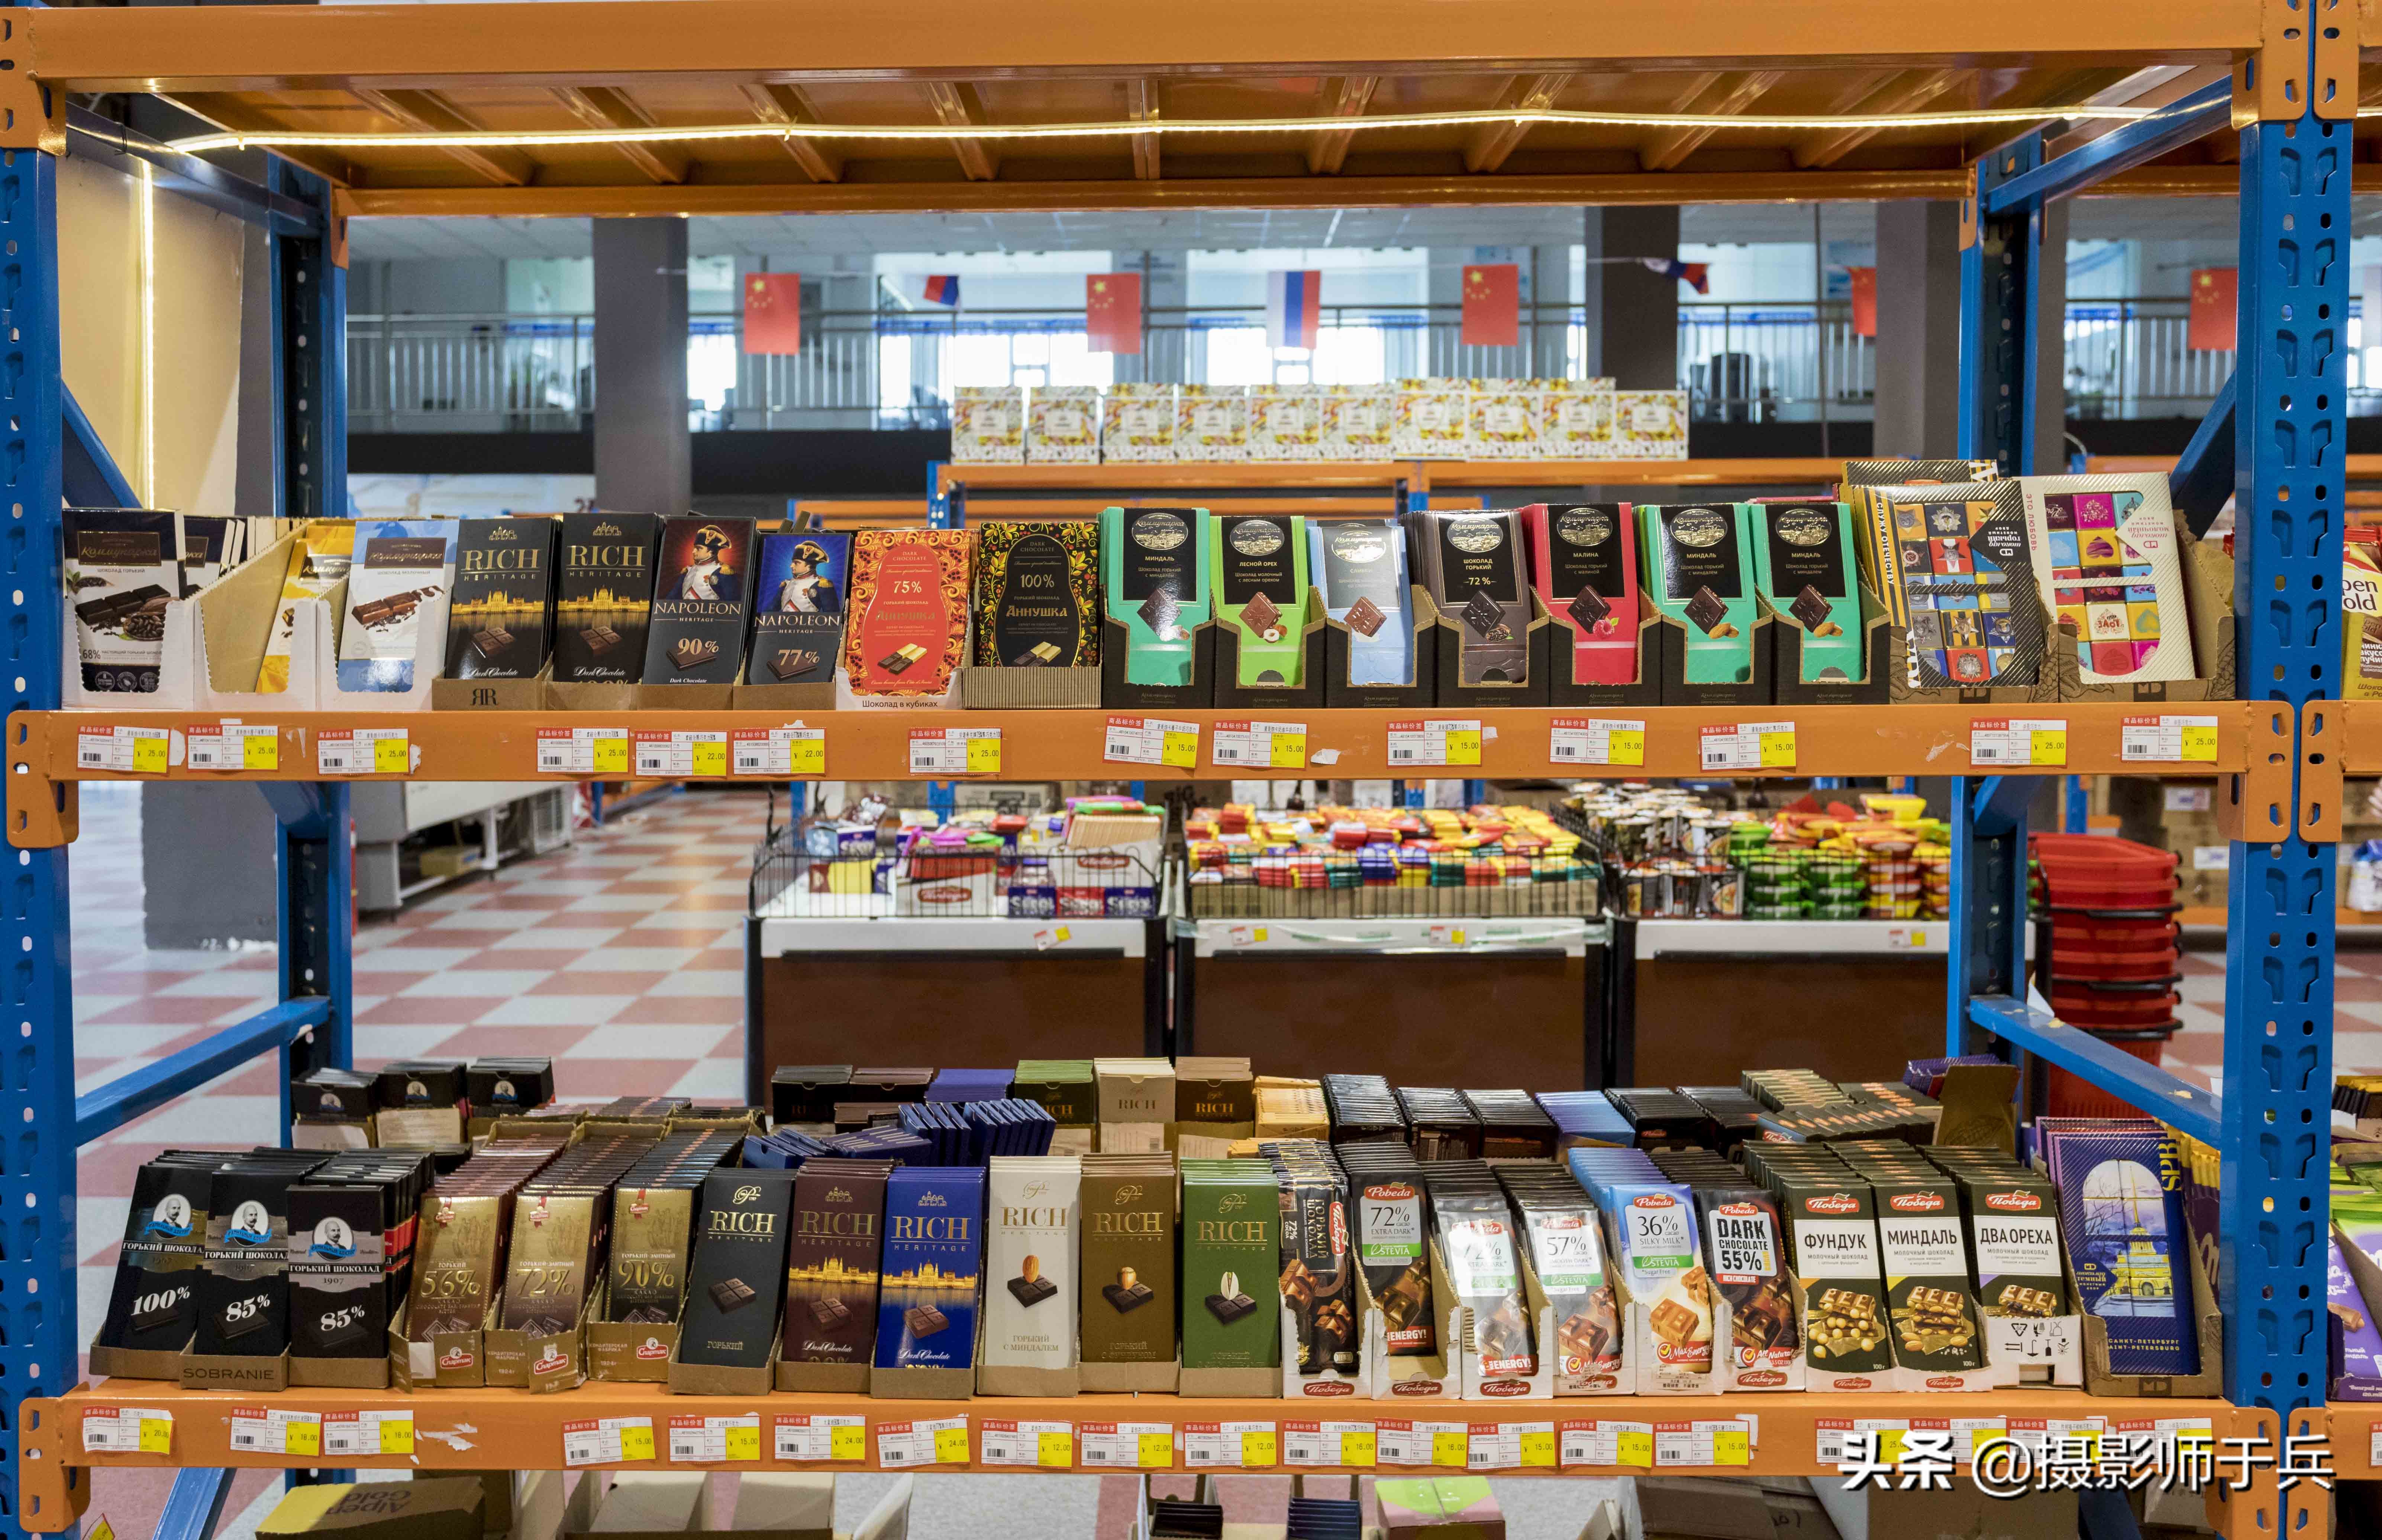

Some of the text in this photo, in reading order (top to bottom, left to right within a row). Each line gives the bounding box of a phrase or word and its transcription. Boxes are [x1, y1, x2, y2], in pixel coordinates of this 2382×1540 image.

[2028, 513, 2037, 550] ЛЮБОВЬ
[1876, 502, 1895, 585] СЛУЖУ ОТЕЧЕСТВУ
[463, 549, 543, 571] RICH
[566, 545, 646, 566] RICH
[893, 581, 922, 593] 75%
[1020, 574, 1055, 588] 100%
[654, 602, 741, 615] NAPOLEON
[755, 615, 840, 627] NAPOLEON
[83, 649, 101, 659] 68%
[1109, 717, 1142, 727] 商品标价签
[1553, 719, 1586, 727] 商品标价签
[1178, 744, 1195, 752] 15.00
[1368, 1186, 1411, 1198] Pobeda
[1636, 1197, 1672, 1207] Pobeda
[1809, 1199, 1856, 1210] Победа
[1894, 1197, 1941, 1207] Победа
[1988, 1196, 2037, 1207] Победа
[1000, 1207, 1068, 1226] RICH
[1371, 1206, 1410, 1226] 72%
[1722, 1206, 1755, 1215] Pobeda
[710, 1211, 777, 1233] RICH
[800, 1211, 877, 1236] RICH
[892, 1216, 972, 1240] RICH
[1092, 1213, 1163, 1232] RICH
[1637, 1216, 1678, 1236] 36%
[1195, 1221, 1268, 1242] RICH
[1716, 1218, 1765, 1240] DARK
[1804, 1233, 1867, 1250] ФУНДУК
[1888, 1229, 1957, 1246] МИНДАЛЬ
[1980, 1229, 2053, 1245] ДВА ОРЕХА
[123, 1242, 162, 1251] ГОРЬКИЙ
[1381, 1246, 1410, 1256] STEVIA
[1547, 1236, 1587, 1256] 57%
[1719, 1239, 1768, 1251] CHOCOLATE
[205, 1251, 289, 1260] ГОРЬКИЙ ШОКОЛАД
[1722, 1250, 1762, 1271] 55%
[290, 1264, 380, 1273] ГОРЬКИЙ ШОКОЛАД
[1651, 1258, 1679, 1267] STEVIA
[617, 1260, 675, 1288] 90%
[420, 1269, 482, 1298] 56%
[516, 1268, 575, 1298] 72%
[130, 1285, 190, 1316] 100%
[226, 1294, 271, 1323] 85%
[321, 1305, 365, 1332] 85%
[1013, 1334, 1049, 1342] ГОРЬКИЙ
[706, 1340, 743, 1350] ГОРЬКИЙ
[638, 1346, 668, 1359] Спартак
[441, 1355, 473, 1368] Спартак
[535, 1355, 569, 1372] Спартак
[183, 1368, 275, 1379] SOBRANIE
[1740, 1373, 1783, 1384] Победа
[233, 1408, 265, 1417] 商品标价签
[565, 1421, 596, 1430] 商品标价签
[878, 1424, 910, 1433] 商品标价签
[983, 1422, 1016, 1430] 商品标价签
[1185, 1424, 1218, 1433] 商品标价签
[1377, 1421, 1410, 1429] 商品标价签
[2120, 1421, 2152, 1429] 商品标价签
[154, 1429, 169, 1438] 20.00
[395, 1431, 413, 1439] 18.00
[1632, 1443, 1650, 1452] 15.00
